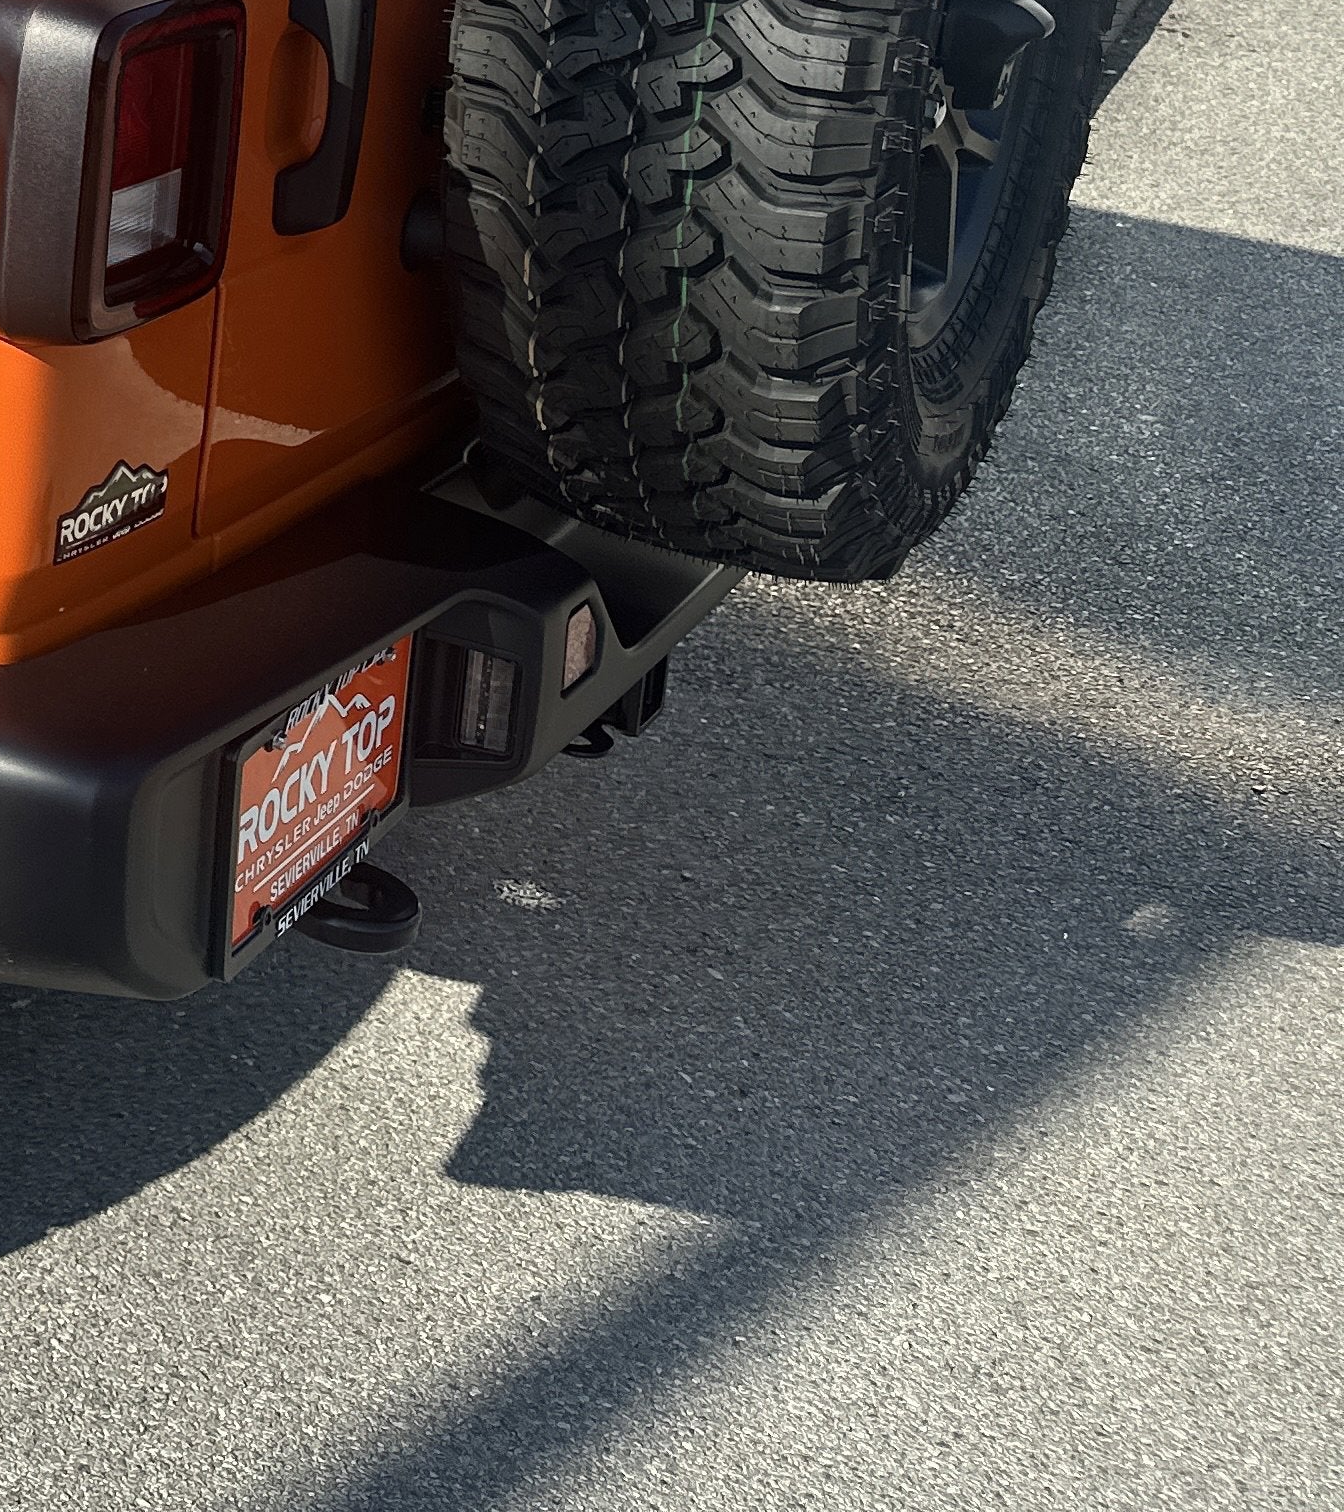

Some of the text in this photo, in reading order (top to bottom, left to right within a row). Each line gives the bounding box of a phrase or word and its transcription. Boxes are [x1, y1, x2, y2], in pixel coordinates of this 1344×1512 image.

[60, 494, 129, 546] ROCKY
[234, 744, 394, 893] CHRYSLER Jeep DODGE
[237, 694, 396, 865] ROCKY TOP
[270, 808, 360, 902] SEVIERVILLE, TN
[276, 836, 370, 938] SEVIERVILLE, TN
